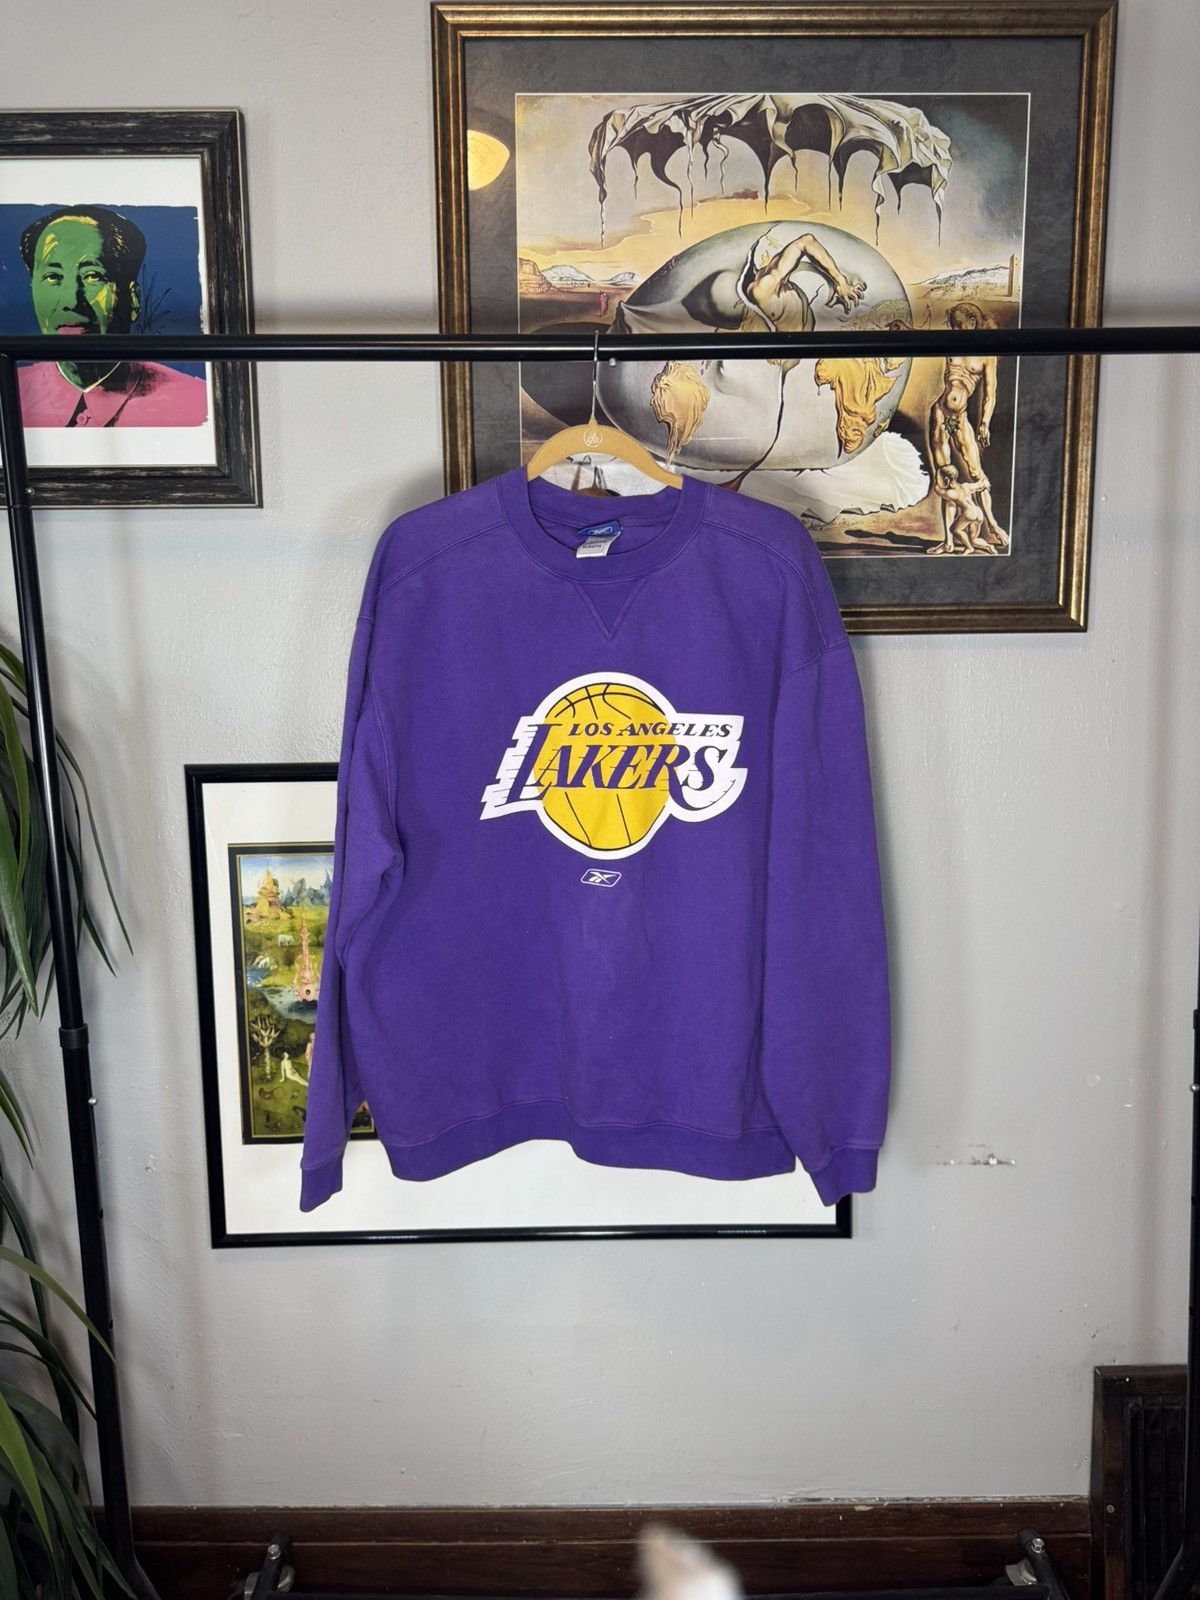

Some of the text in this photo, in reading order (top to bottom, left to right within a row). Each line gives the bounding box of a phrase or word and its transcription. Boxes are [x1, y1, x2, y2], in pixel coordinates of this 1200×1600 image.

[568, 722, 733, 738] LOS ANGELES
[494, 723, 736, 811] LAKERS
